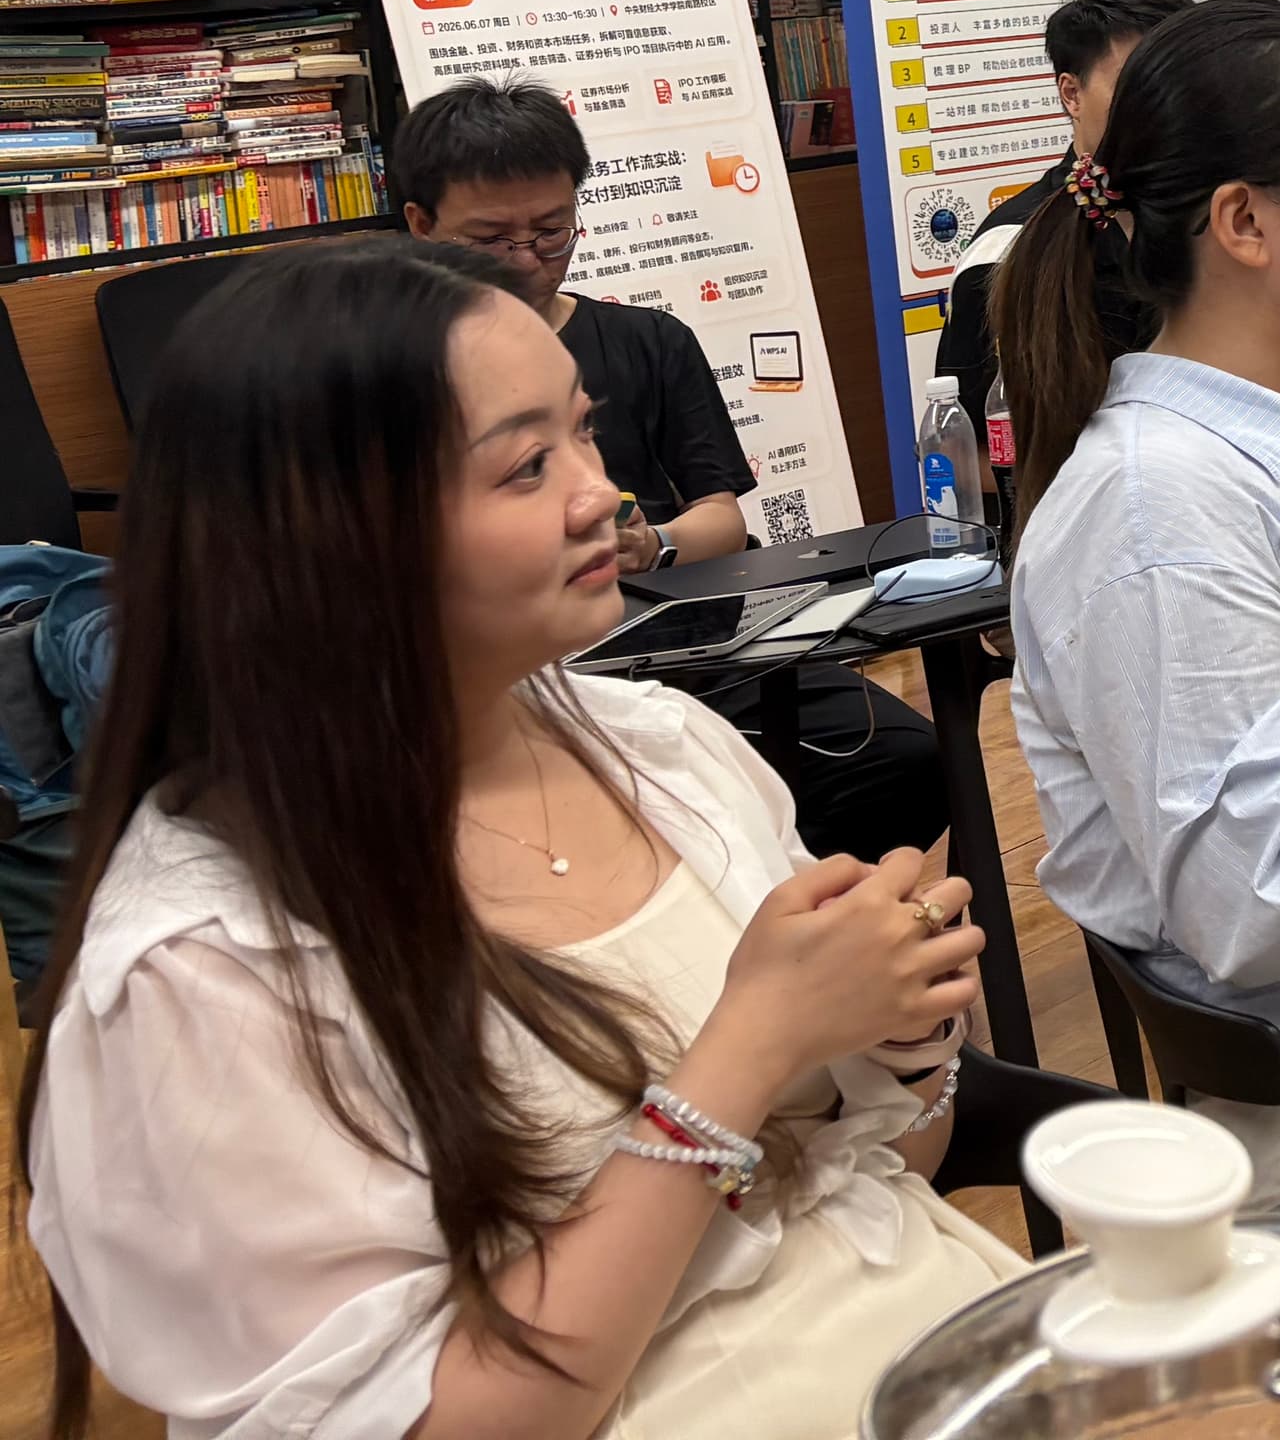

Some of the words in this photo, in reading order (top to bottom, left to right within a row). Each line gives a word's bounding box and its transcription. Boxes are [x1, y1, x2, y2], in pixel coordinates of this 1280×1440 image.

[437, 19, 491, 32] 2026.06.07
[493, 15, 511, 28] 周日
[930, 21, 961, 35] 投资人
[898, 26, 907, 40] 2
[623, 44, 640, 57] IPO
[903, 67, 911, 81] 3
[958, 63, 971, 74] BP
[678, 77, 694, 88] IPO
[935, 104, 976, 118] 一站对接
[907, 112, 916, 126] 4
[912, 154, 920, 168] 5
